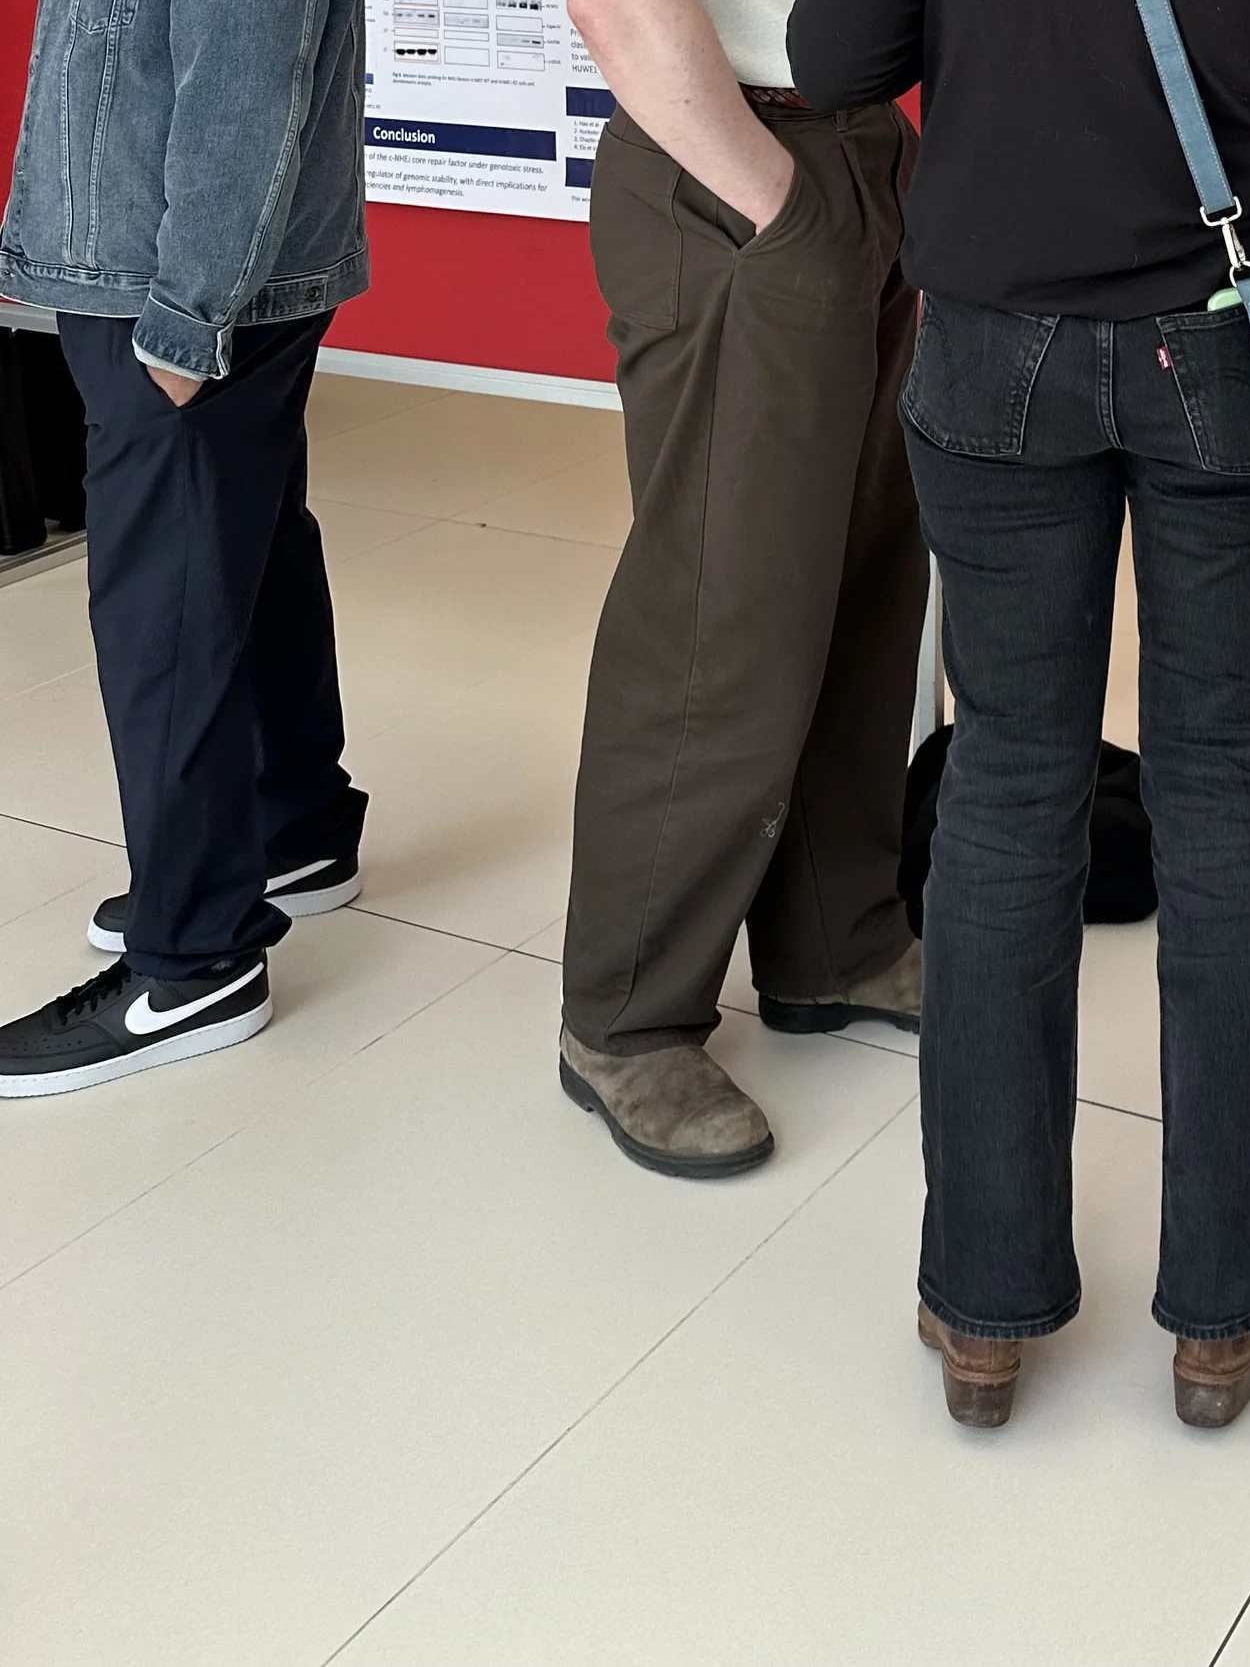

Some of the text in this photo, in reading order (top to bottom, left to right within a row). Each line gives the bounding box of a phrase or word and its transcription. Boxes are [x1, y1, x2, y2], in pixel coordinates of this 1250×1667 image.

[373, 126, 436, 145] Conclusion
[368, 152, 376, 160] of
[376, 152, 388, 161] the
[427, 157, 447, 166] repair
[448, 158, 467, 167] factor
[468, 161, 488, 169] under
[366, 181, 391, 191] ciencies
[392, 184, 405, 192] and
[395, 171, 402, 179] of
[403, 173, 430, 182] genomic
[460, 177, 474, 186] with
[475, 179, 495, 188] direct
[495, 180, 536, 191] implications
[537, 183, 548, 192] for
